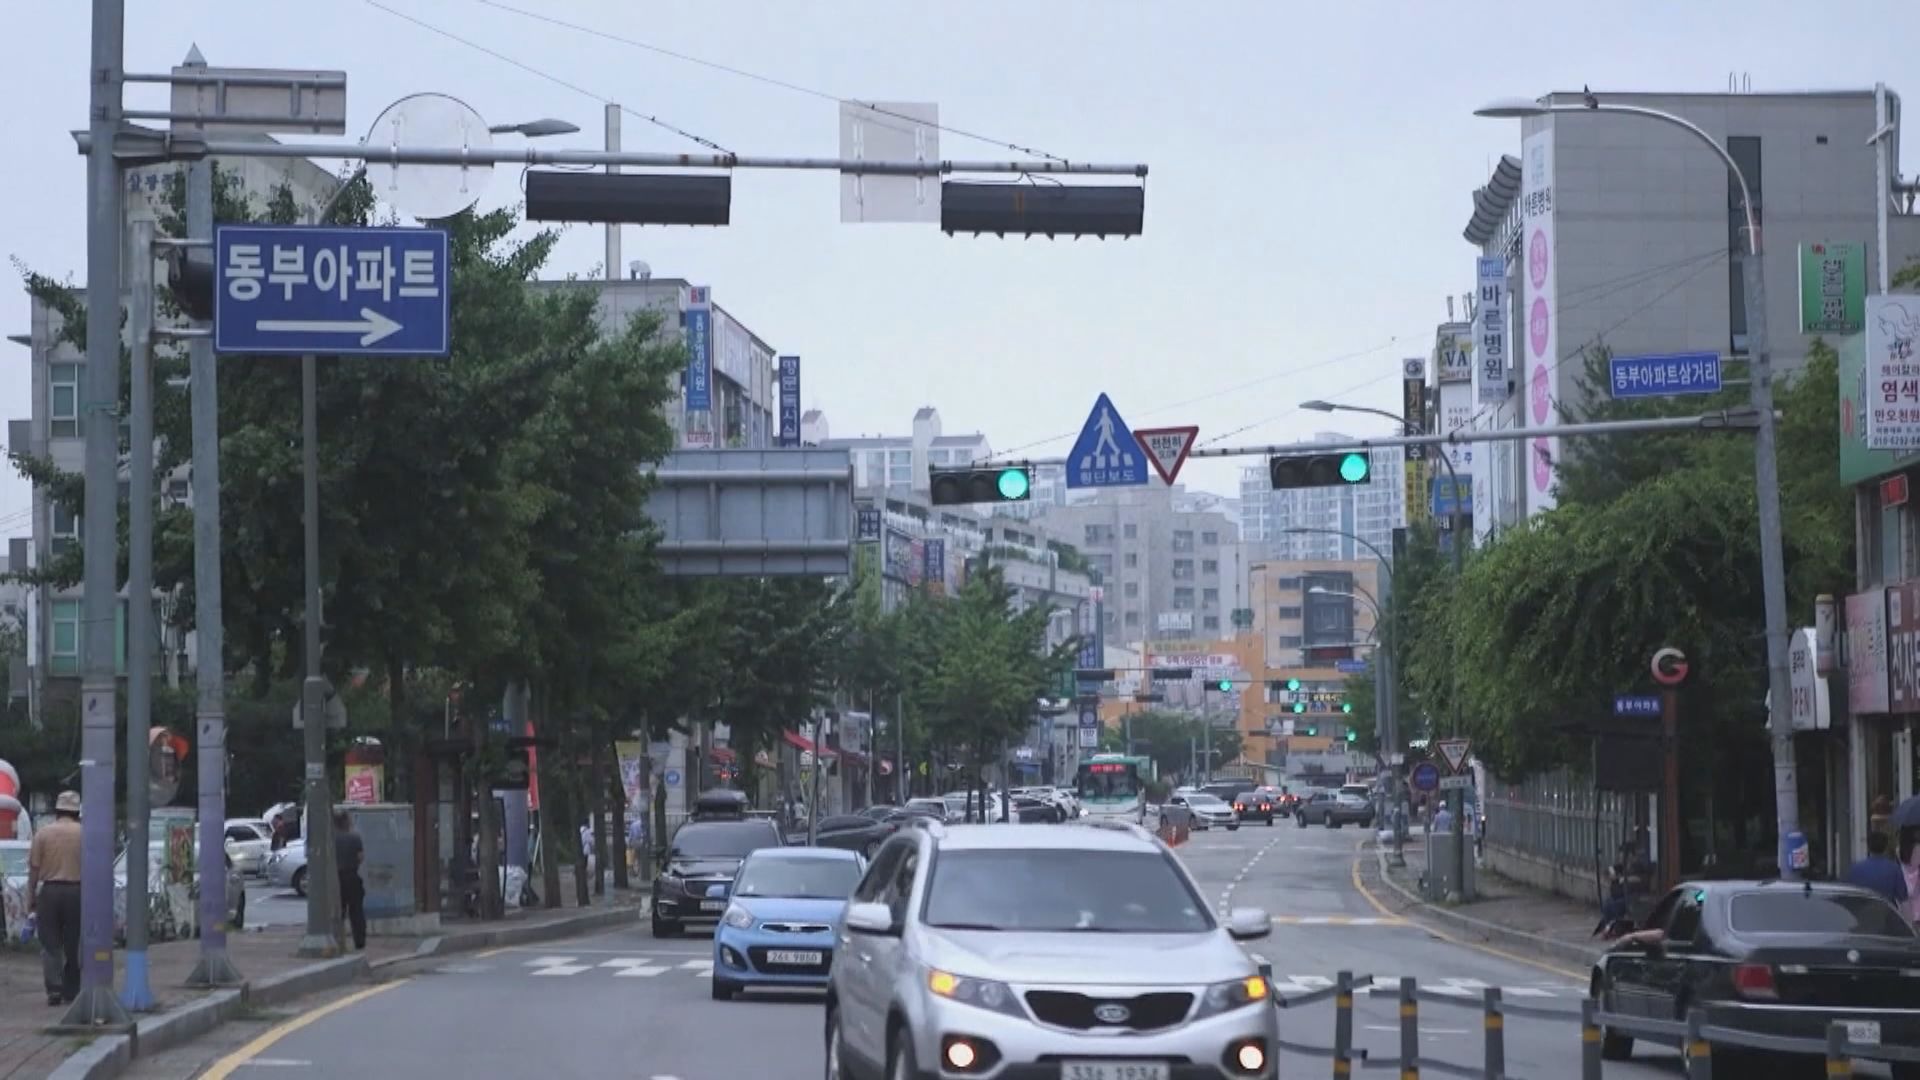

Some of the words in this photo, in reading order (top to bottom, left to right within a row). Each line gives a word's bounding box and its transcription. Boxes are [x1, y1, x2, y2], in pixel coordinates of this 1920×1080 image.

[225, 245, 439, 302] 동부아파트
[1482, 284, 1503, 381] 바른병원
[1615, 360, 1717, 389] 동부아파트삼거리
[1080, 469, 1136, 484] 횡단보도
